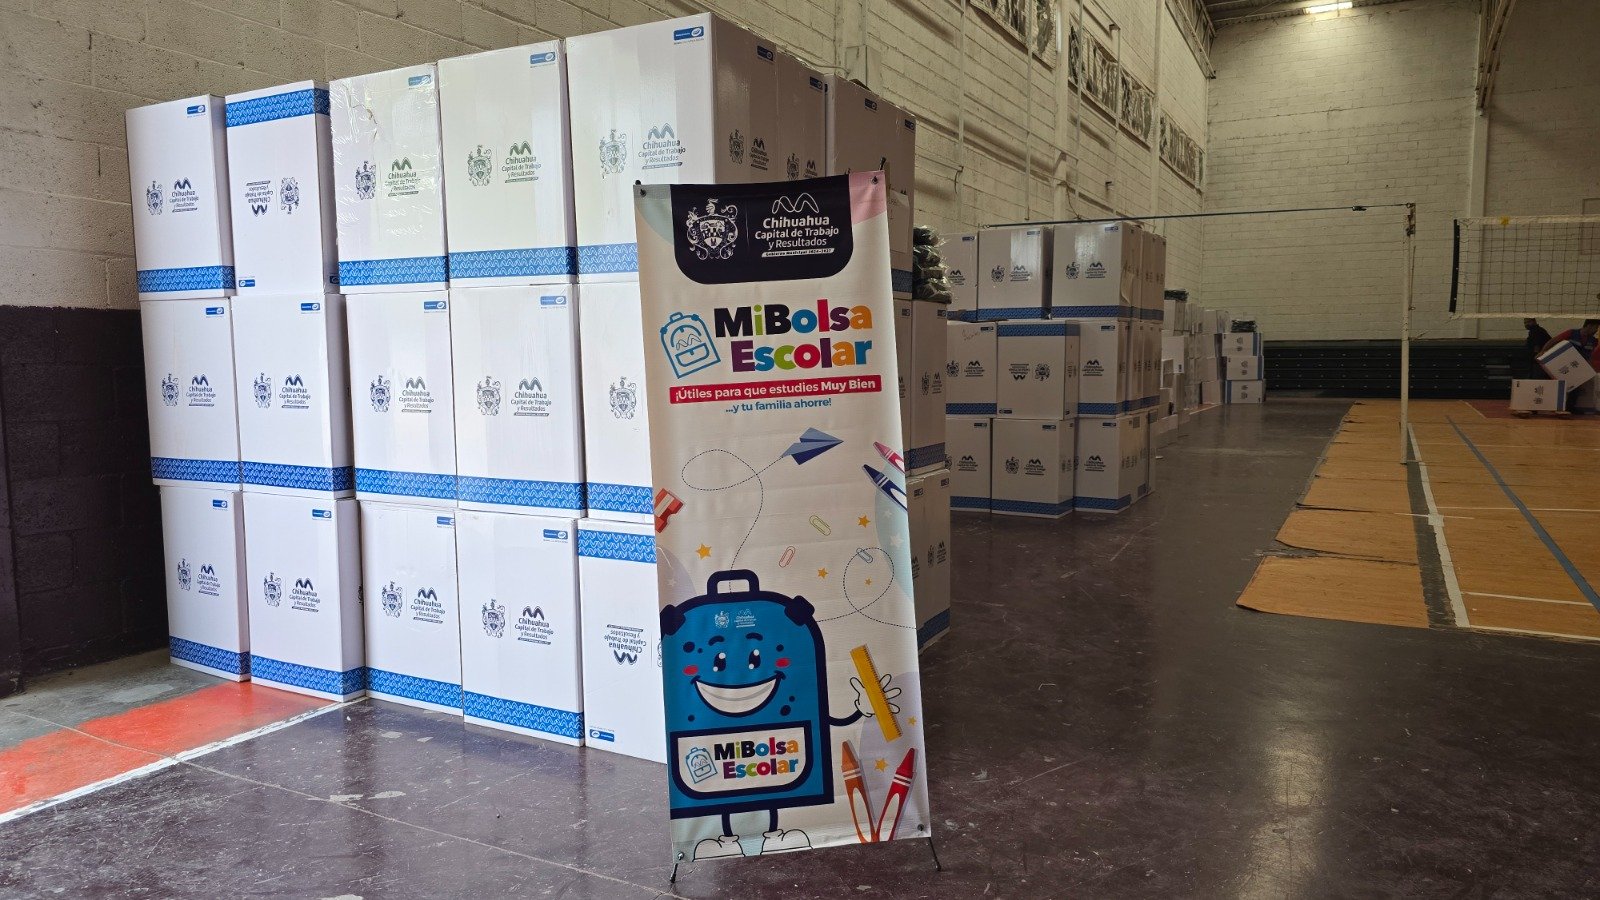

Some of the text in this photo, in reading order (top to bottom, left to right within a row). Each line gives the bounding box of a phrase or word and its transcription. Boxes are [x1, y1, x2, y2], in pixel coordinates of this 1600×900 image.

[643, 140, 680, 149] Chihuahua
[638, 150, 658, 158] Capital
[666, 148, 686, 156] Trabajo
[506, 156, 536, 165] Chihuahua
[502, 165, 518, 173] Capital
[525, 163, 541, 171] Trabajo
[763, 215, 830, 229] Chihuahua
[755, 226, 839, 241] Capital de Trabajo
[768, 237, 827, 250] y Resultados
[731, 338, 872, 372] Escolar
[676, 379, 876, 402] ¡Útiles para que estudies Muy Bien
[742, 403, 753, 412] tu
[755, 399, 792, 410] familia
[794, 398, 832, 408] ahorre!
[414, 599, 441, 608] Chihuahua
[519, 618, 549, 628] Chihuahua
[514, 624, 531, 633] Capital
[538, 627, 554, 636] Trabajo
[525, 632, 547, 640] Resultados
[604, 634, 621, 643] Trabajo
[629, 638, 646, 646] Capital
[609, 642, 642, 654] Chihuahua
[723, 758, 799, 779] Escolar
